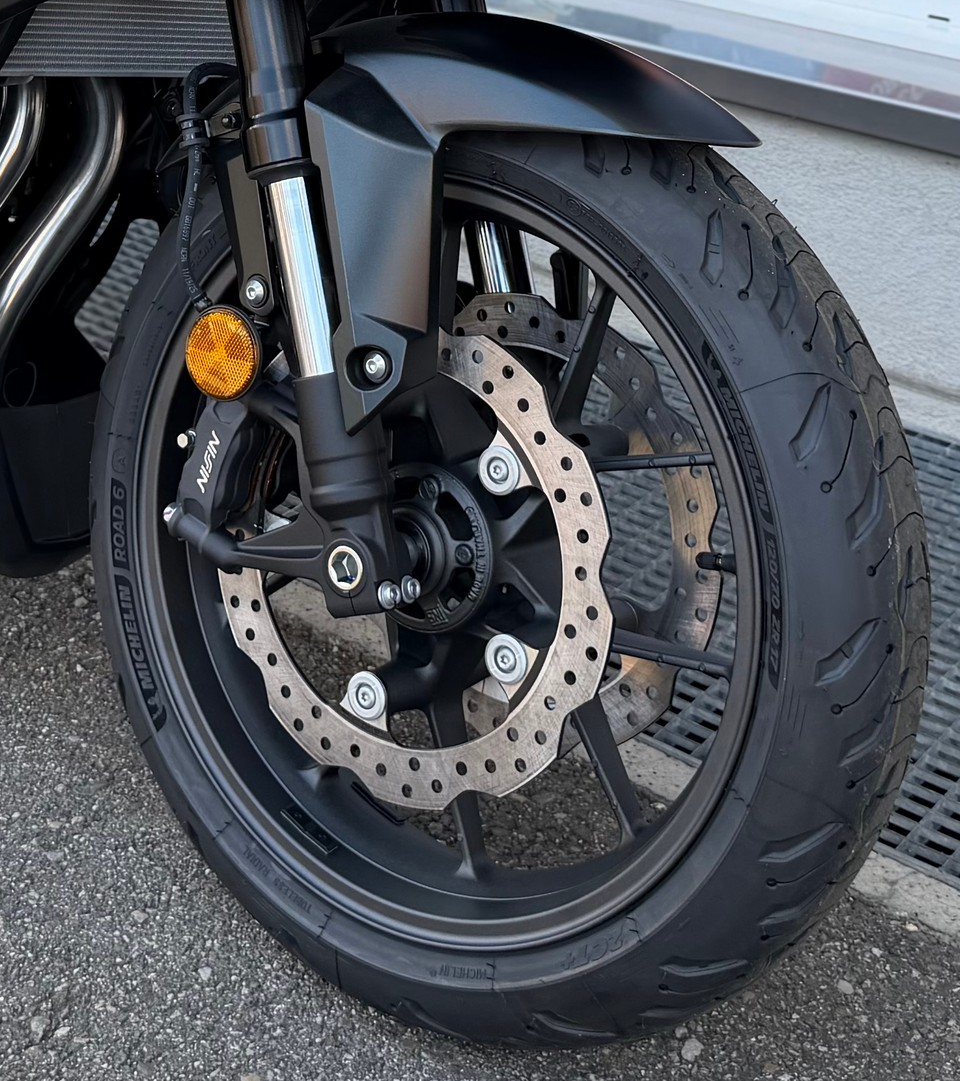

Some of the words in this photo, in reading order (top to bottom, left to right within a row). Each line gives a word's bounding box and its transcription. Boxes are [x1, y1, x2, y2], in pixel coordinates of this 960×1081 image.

[719, 386, 769, 513] MICHELIN
[112, 485, 125, 500] 6
[112, 504, 127, 562] ROAD
[766, 537, 780, 610] 120/70
[118, 584, 154, 689] MICHELIN
[770, 614, 781, 646] ZR
[769, 648, 779, 672] 17
[243, 844, 271, 876] RADIAL
[439, 963, 487, 980] MICHELIN
